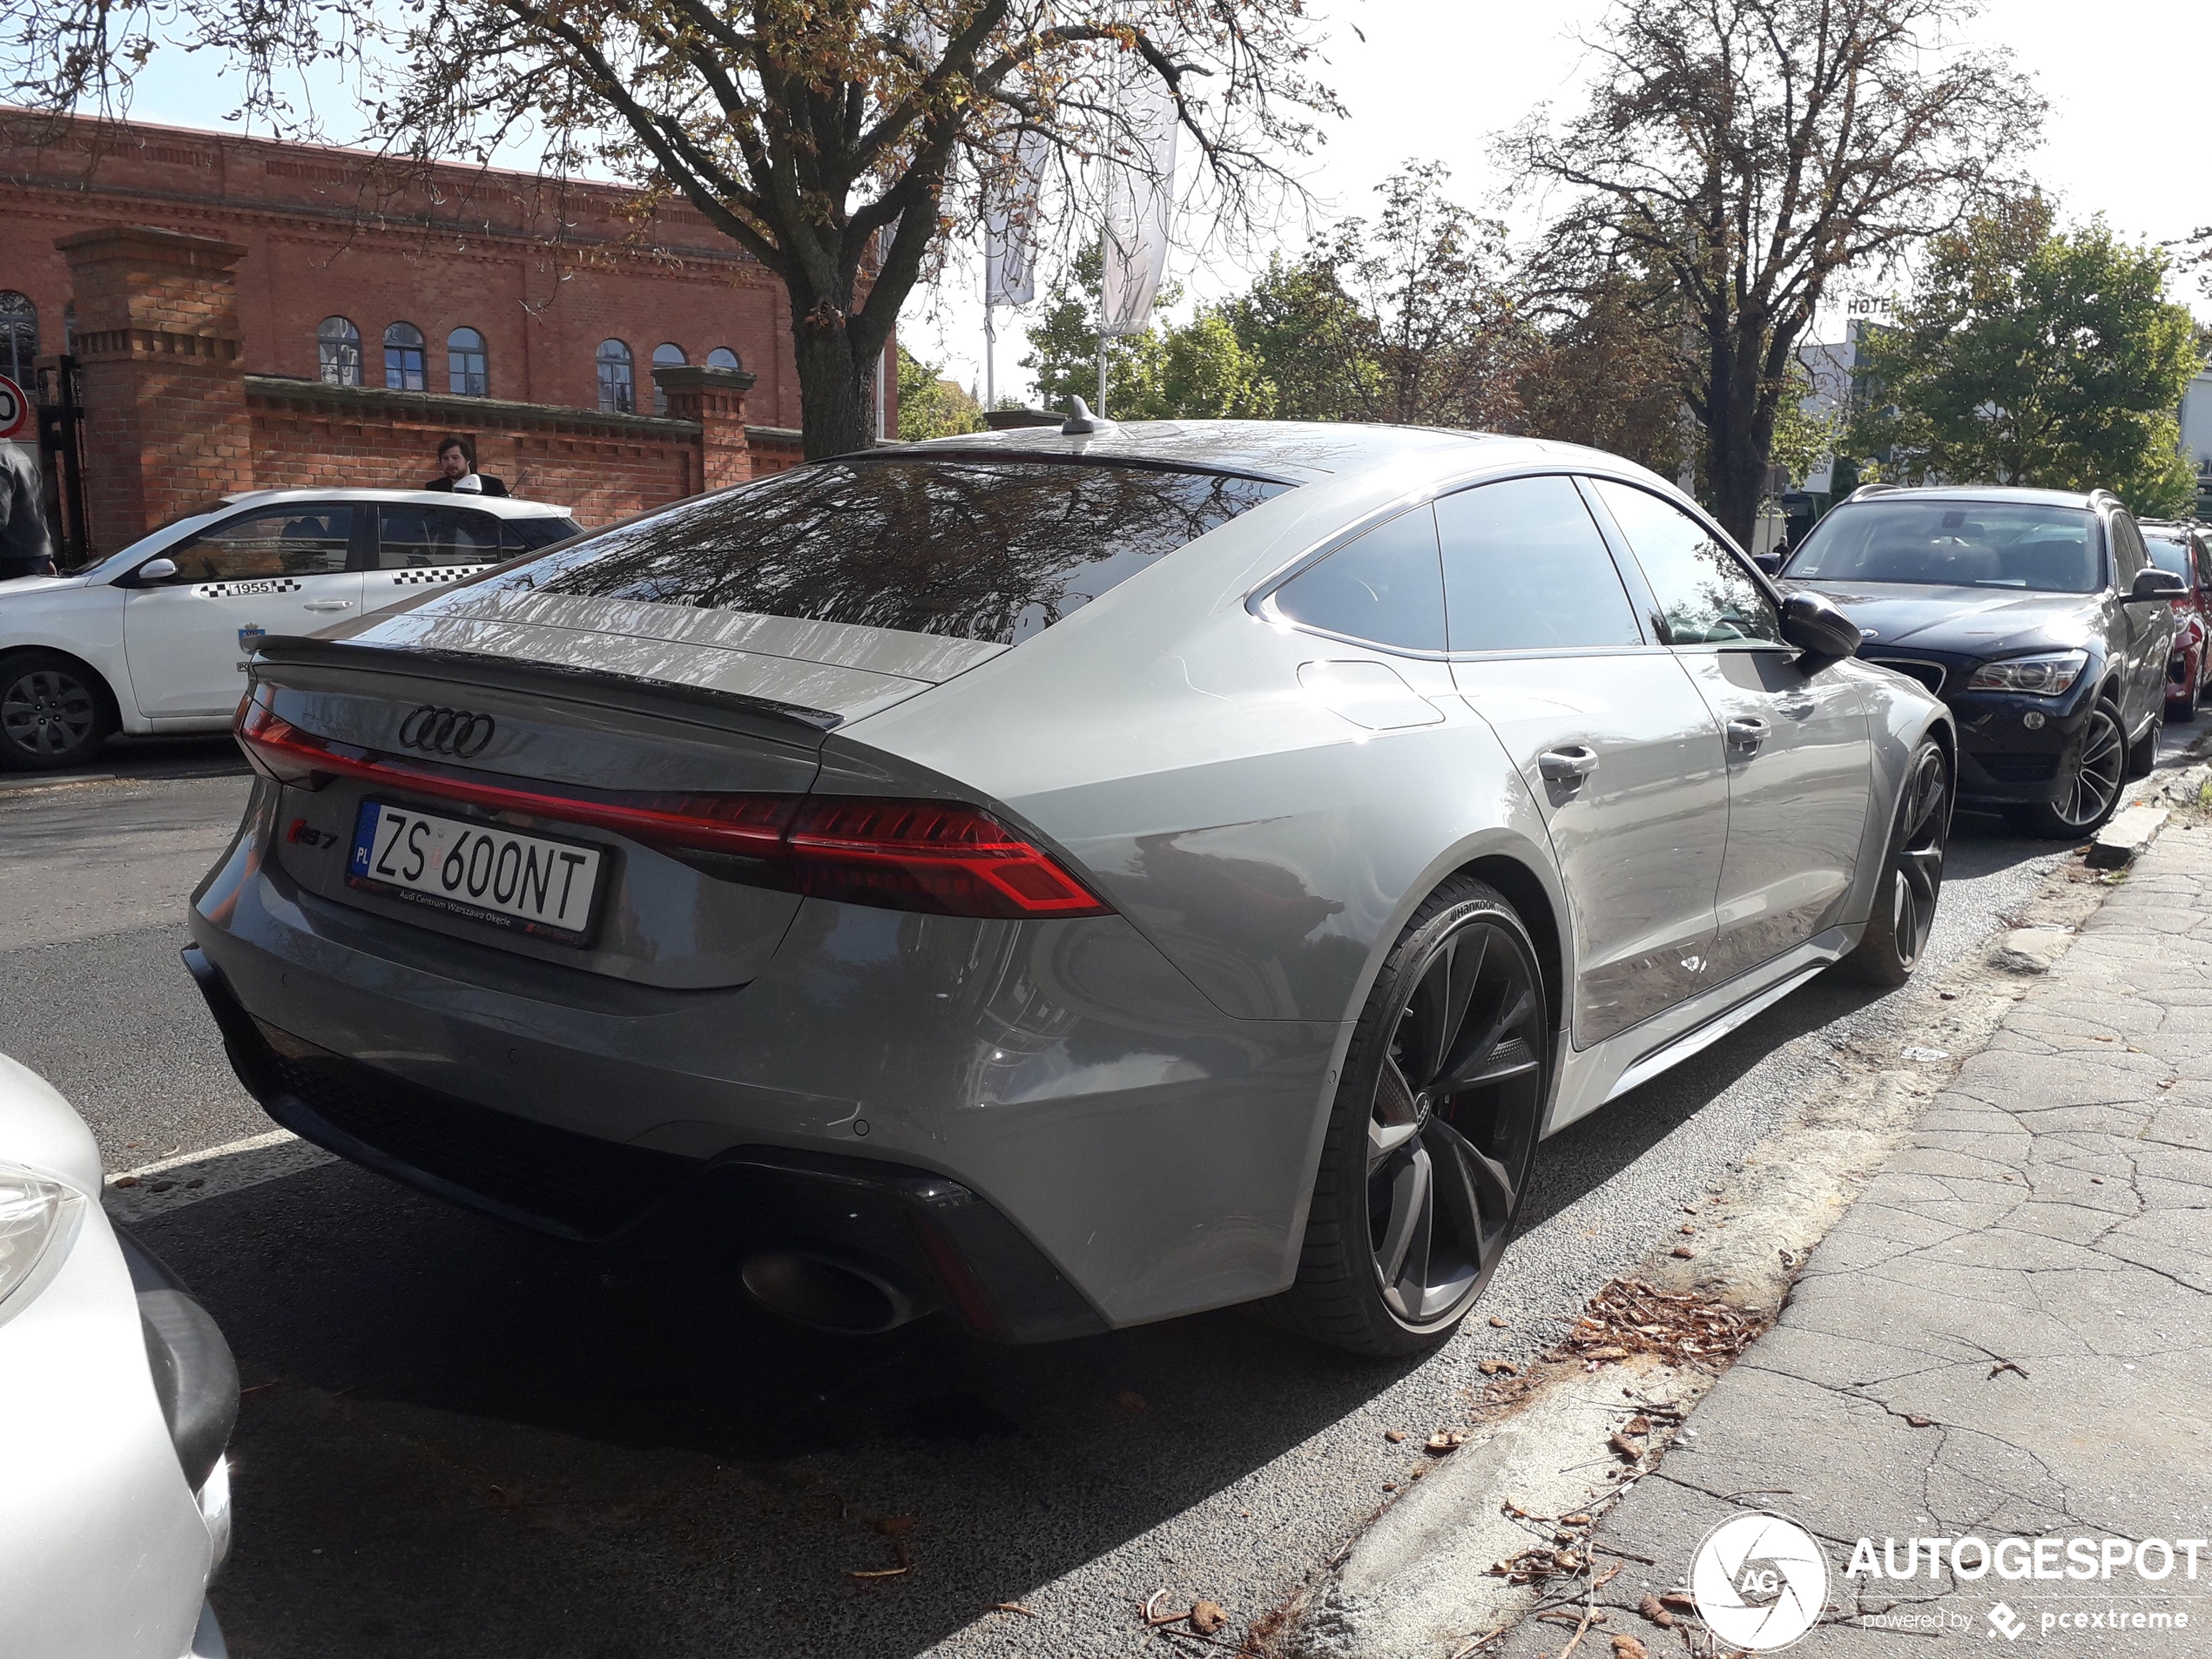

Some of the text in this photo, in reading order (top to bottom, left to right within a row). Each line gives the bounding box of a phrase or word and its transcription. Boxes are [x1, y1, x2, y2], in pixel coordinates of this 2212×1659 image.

[1848, 297, 1891, 314] HOTE
[0, 391, 16, 421] 0
[233, 583, 269, 594] 1955
[356, 846, 368, 865] PL
[376, 813, 587, 920] ZS 600NT
[399, 890, 511, 926] Audi Centrum Warszawa Okęcie
